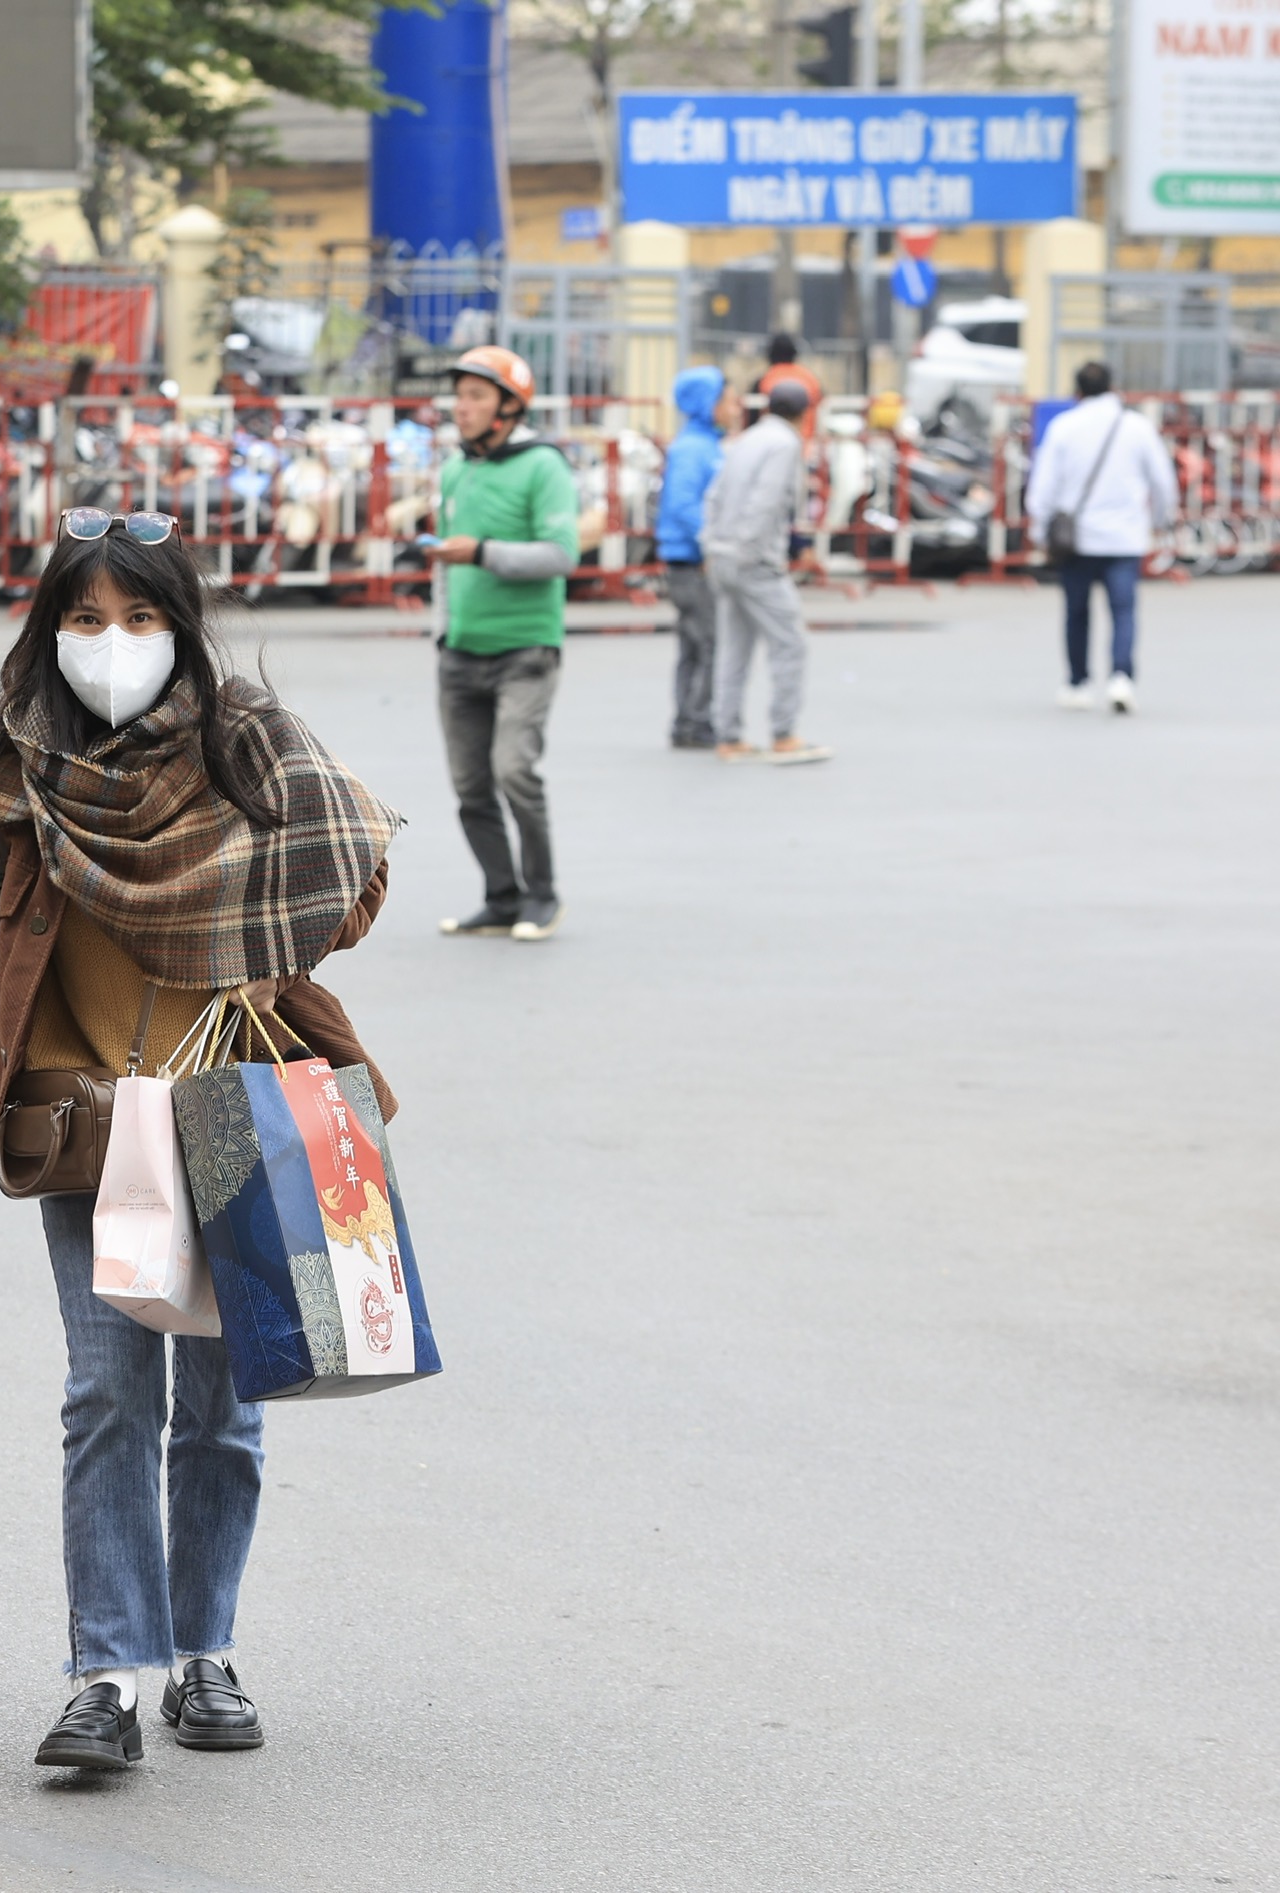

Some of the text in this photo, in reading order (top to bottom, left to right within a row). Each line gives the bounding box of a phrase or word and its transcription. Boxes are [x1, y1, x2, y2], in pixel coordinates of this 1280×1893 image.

[928, 116, 981, 164] XE
[984, 106, 1070, 164] MÁY
[728, 166, 974, 222] NGÀY VÀ ĐÊM
[321, 1078, 361, 1191] 謹賀新年
